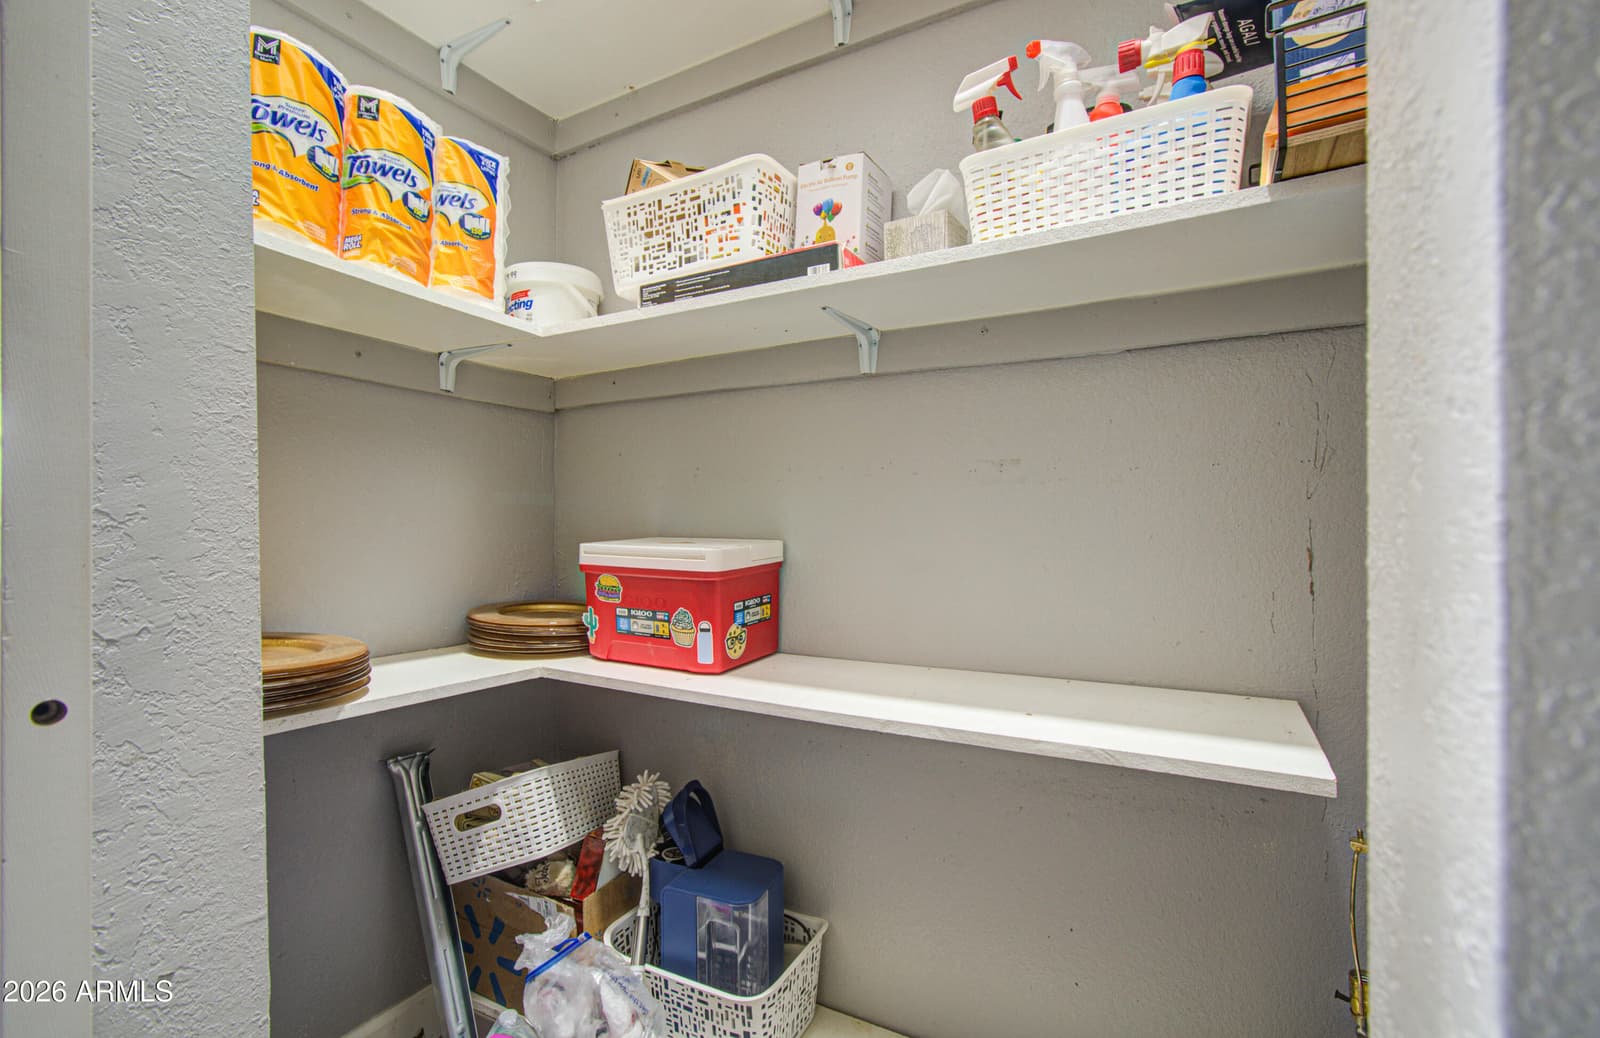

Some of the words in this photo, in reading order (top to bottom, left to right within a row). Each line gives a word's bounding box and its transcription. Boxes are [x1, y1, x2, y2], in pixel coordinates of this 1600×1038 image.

[252, 160, 271, 170] ong
[278, 169, 319, 191] Absorbent
[347, 155, 418, 188] Towels
[435, 191, 477, 210] wels
[507, 299, 534, 314] cting
[630, 609, 653, 617] IGLOO
